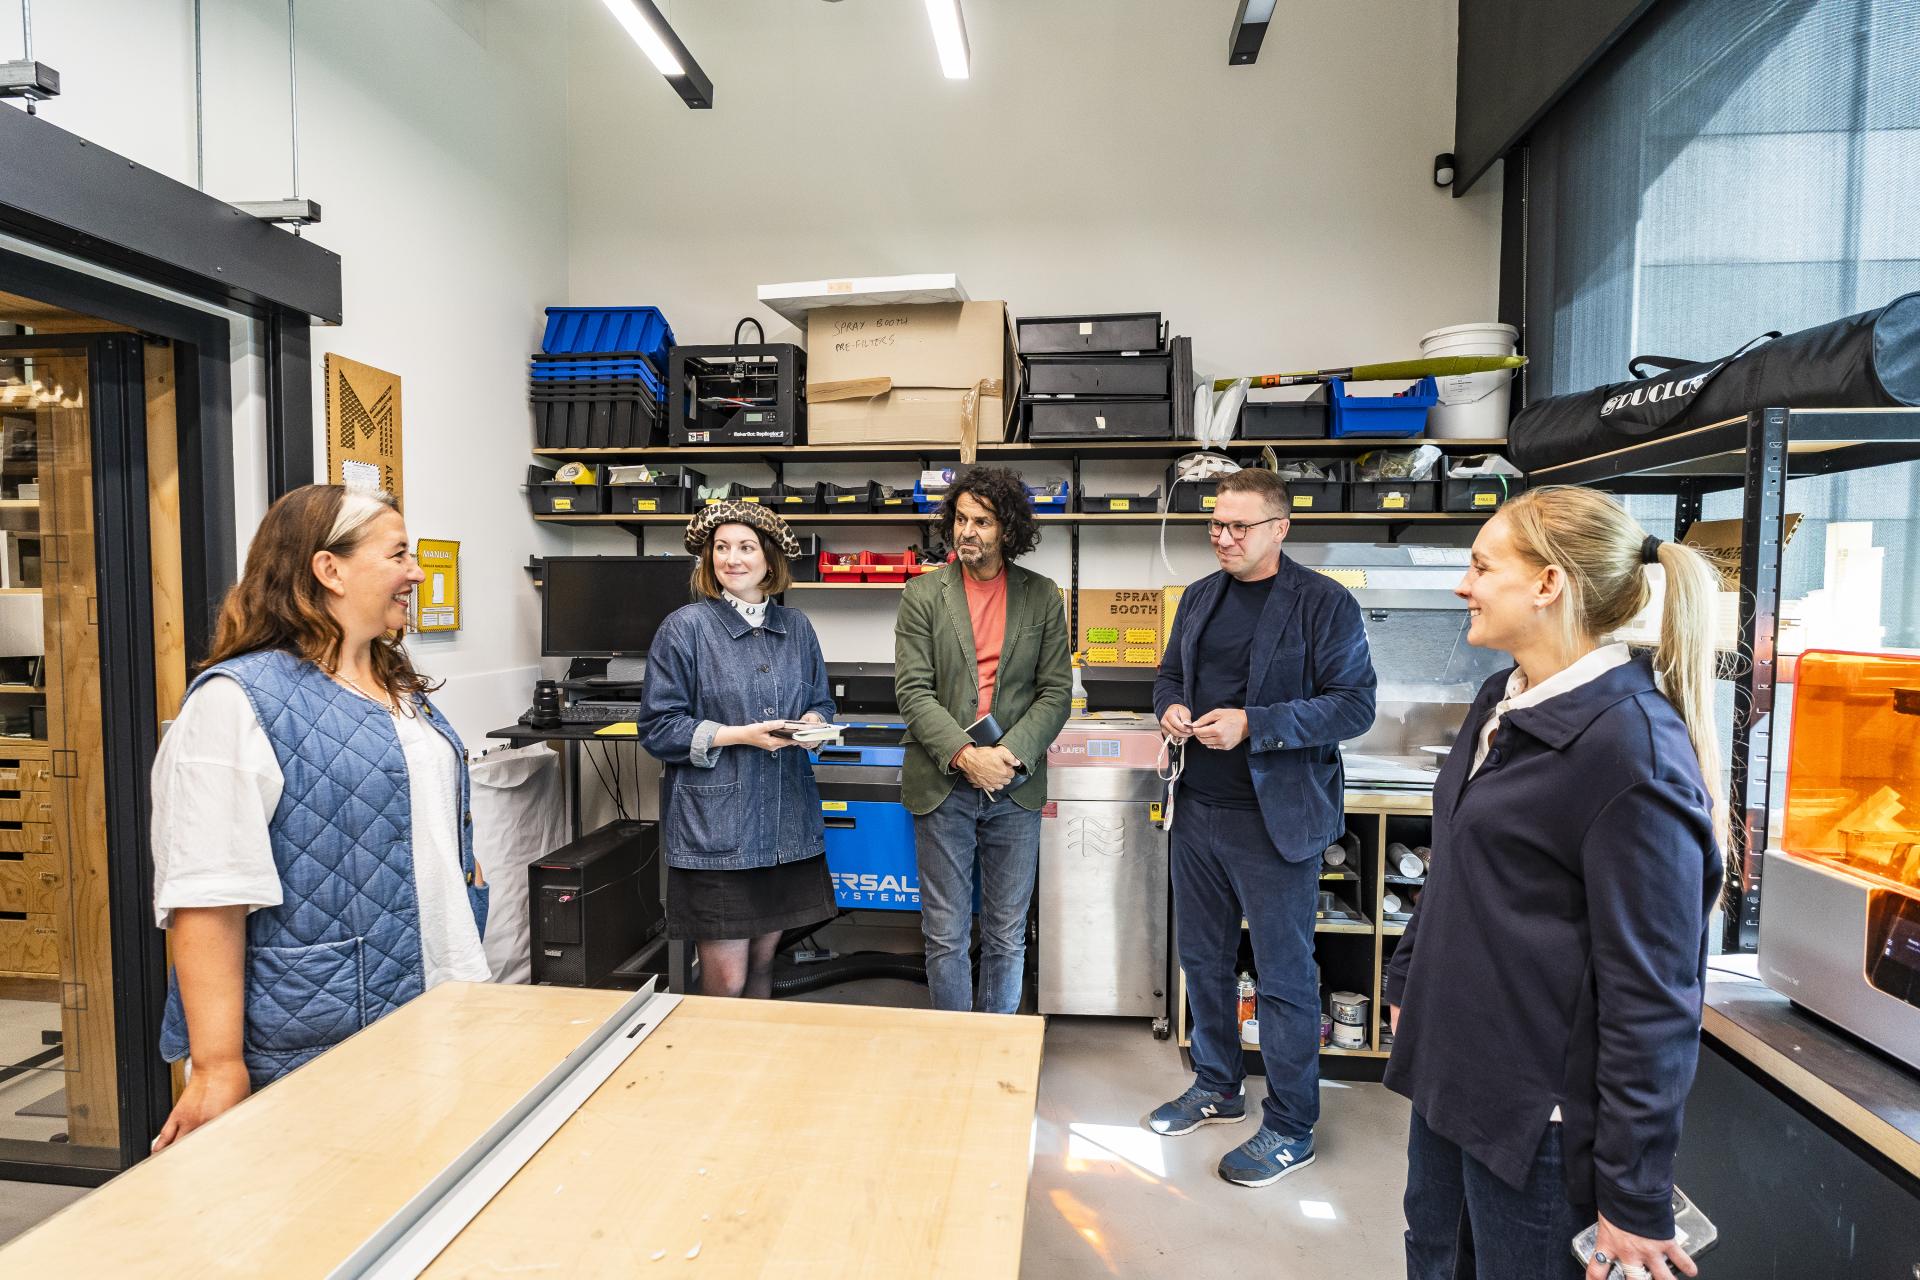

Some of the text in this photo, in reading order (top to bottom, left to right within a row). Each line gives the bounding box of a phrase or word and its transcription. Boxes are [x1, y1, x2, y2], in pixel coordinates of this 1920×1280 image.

[833, 317, 909, 336] SPRAY BOOTH
[835, 334, 895, 352] PRE-FILTERS
[1115, 592, 1158, 602] SPRAY
[1110, 604, 1158, 615] BOOTH
[830, 872, 920, 892] ERSAL
[840, 891, 920, 903] YSTEMS
[1200, 1104, 1218, 1118] N
[1275, 1148, 1294, 1168] N
